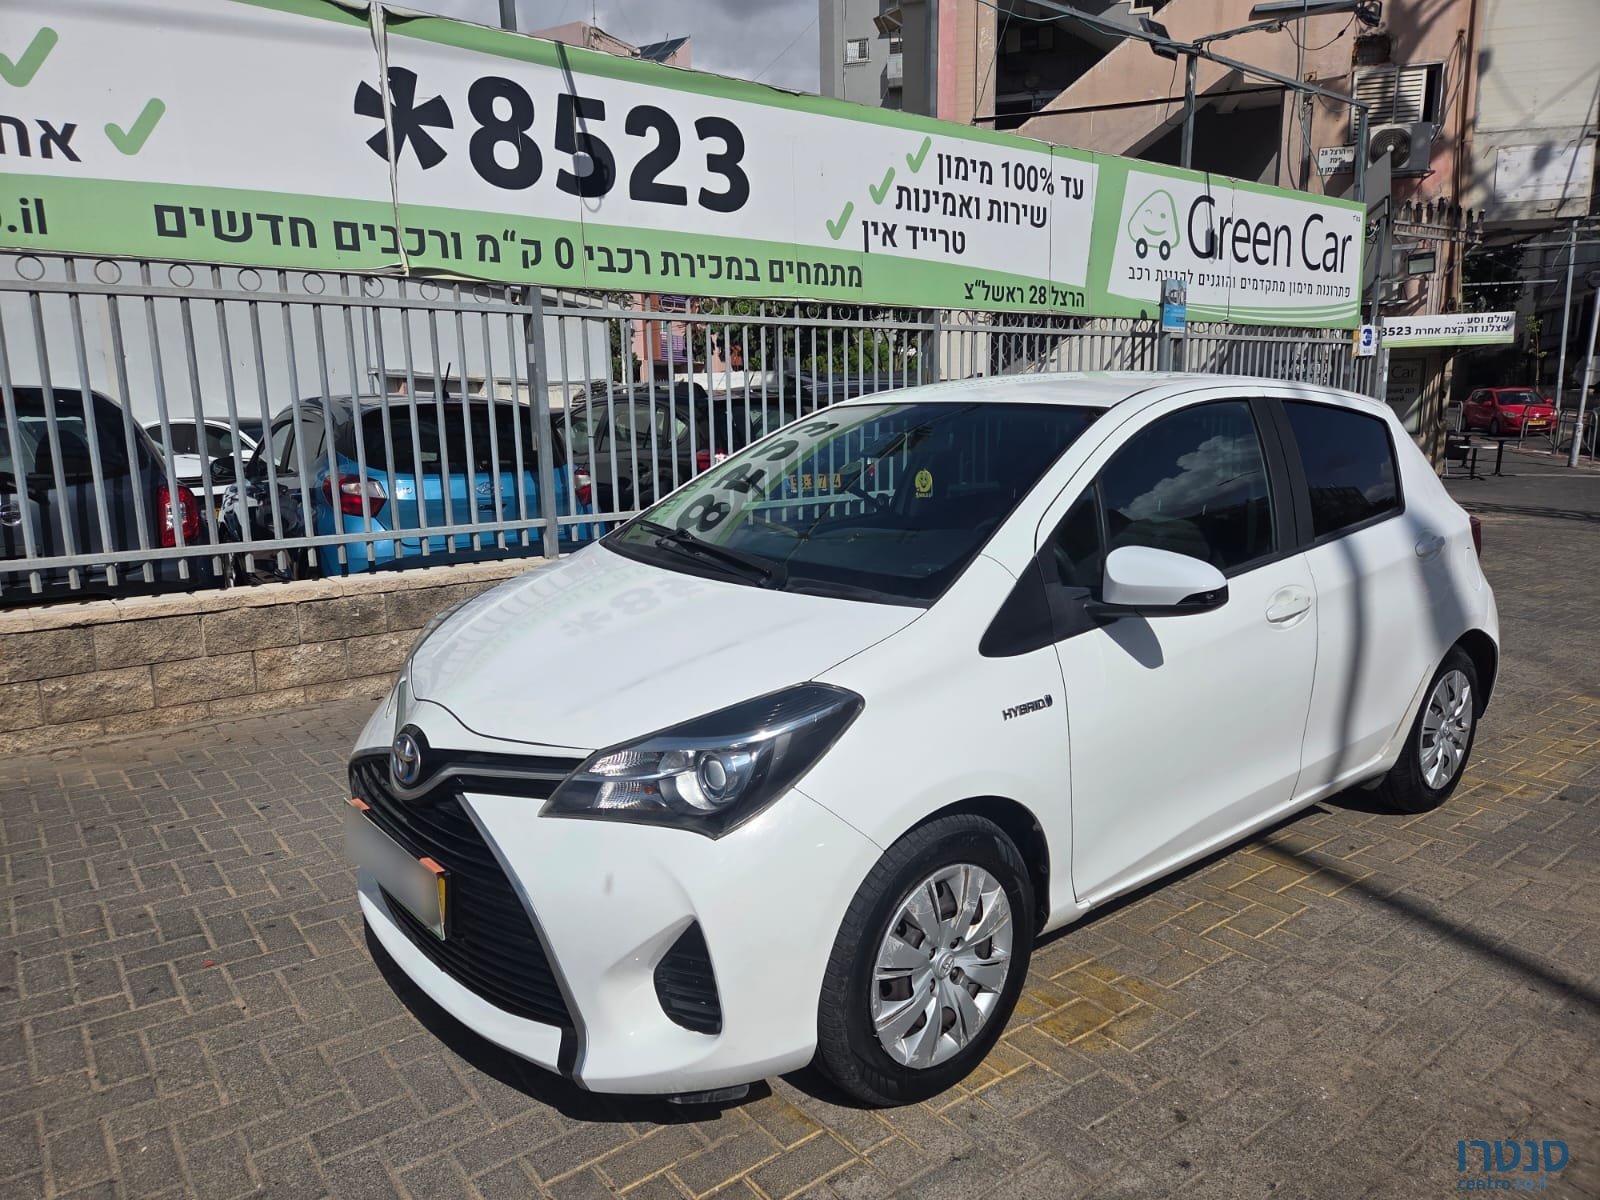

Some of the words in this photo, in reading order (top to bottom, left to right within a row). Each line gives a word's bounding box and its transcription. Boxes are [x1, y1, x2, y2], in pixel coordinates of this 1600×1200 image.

[937, 153, 993, 185] מימון
[1001, 161, 1054, 195] 100%
[1061, 175, 1084, 200] עד
[0, 197, 48, 235] .il
[896, 185, 981, 220] ואמינות
[987, 199, 1047, 228] שירות
[154, 204, 318, 249] חדשים
[333, 221, 463, 260] ורכבים
[862, 220, 898, 253] אין
[905, 225, 966, 254] טרייד
[1187, 195, 1292, 267] Green
[1301, 213, 1353, 273] Car
[476, 229, 542, 269] ק"מ
[554, 237, 574, 269] 0
[584, 246, 651, 275] רכבי
[661, 251, 760, 282] במכירת
[769, 259, 862, 288] מתמחים
[1128, 266, 1151, 281] רכב
[1198, 273, 1236, 289] והוגנים
[1029, 286, 1048, 305] 28
[1050, 286, 1085, 308] הרצל
[1240, 277, 1286, 295] מתקדמים
[1289, 281, 1313, 296] מימון
[1316, 284, 1350, 298] פתרונות
[1414, 327, 1441, 335] אחרת
[1444, 326, 1465, 336] קצת
[1481, 324, 1509, 332] אצלנו
[1487, 315, 1510, 324] שלם
[1002, 698, 1046, 721] HYBRID
